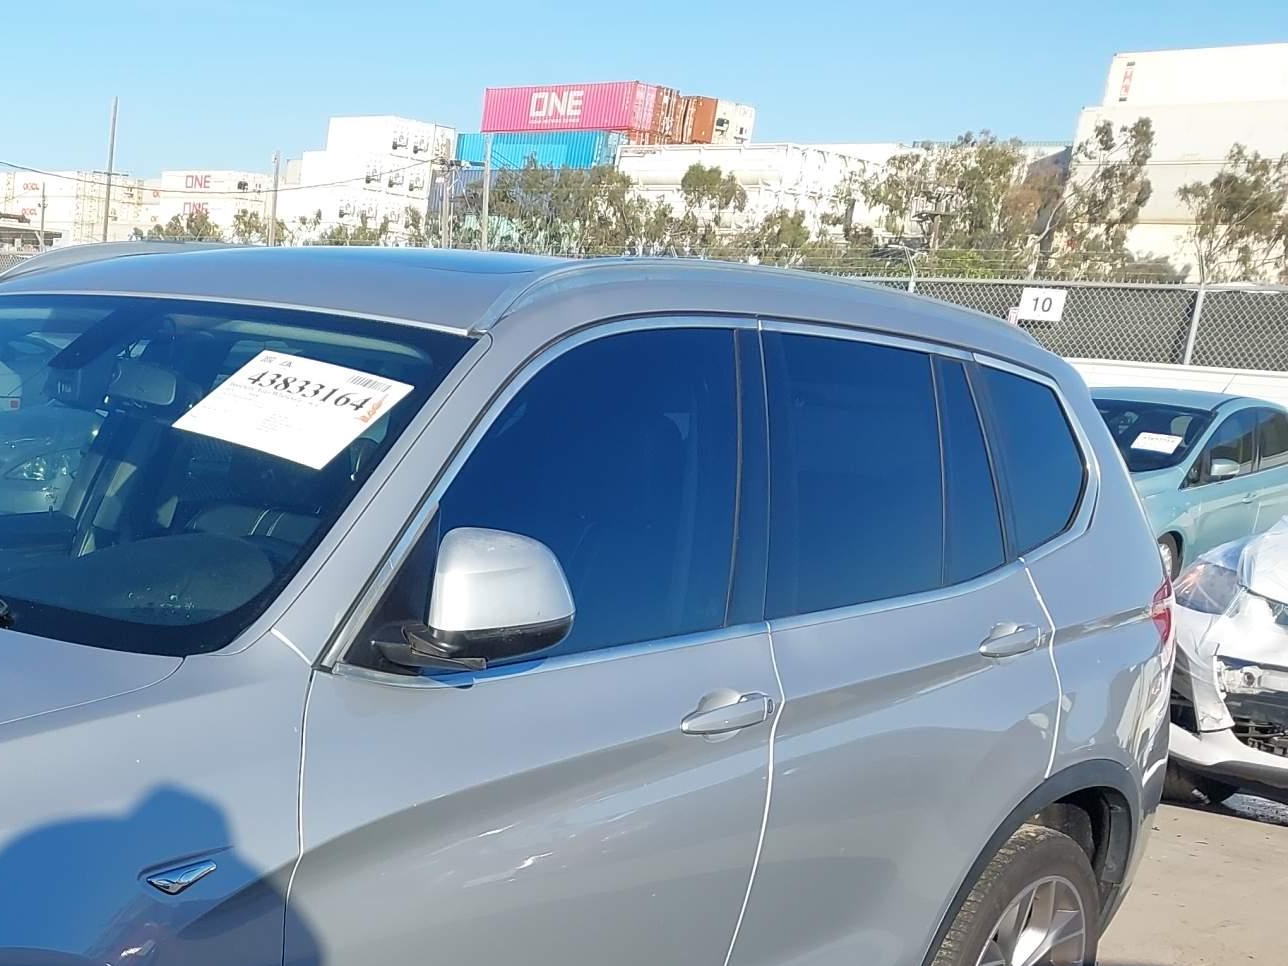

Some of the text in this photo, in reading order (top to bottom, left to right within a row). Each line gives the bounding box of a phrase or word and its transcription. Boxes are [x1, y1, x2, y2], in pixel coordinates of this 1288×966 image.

[529, 90, 584, 117] ONE
[23, 182, 39, 191] OOCL
[185, 175, 211, 189] ONE
[1033, 297, 1053, 312] 10
[248, 370, 373, 411] 43833164
